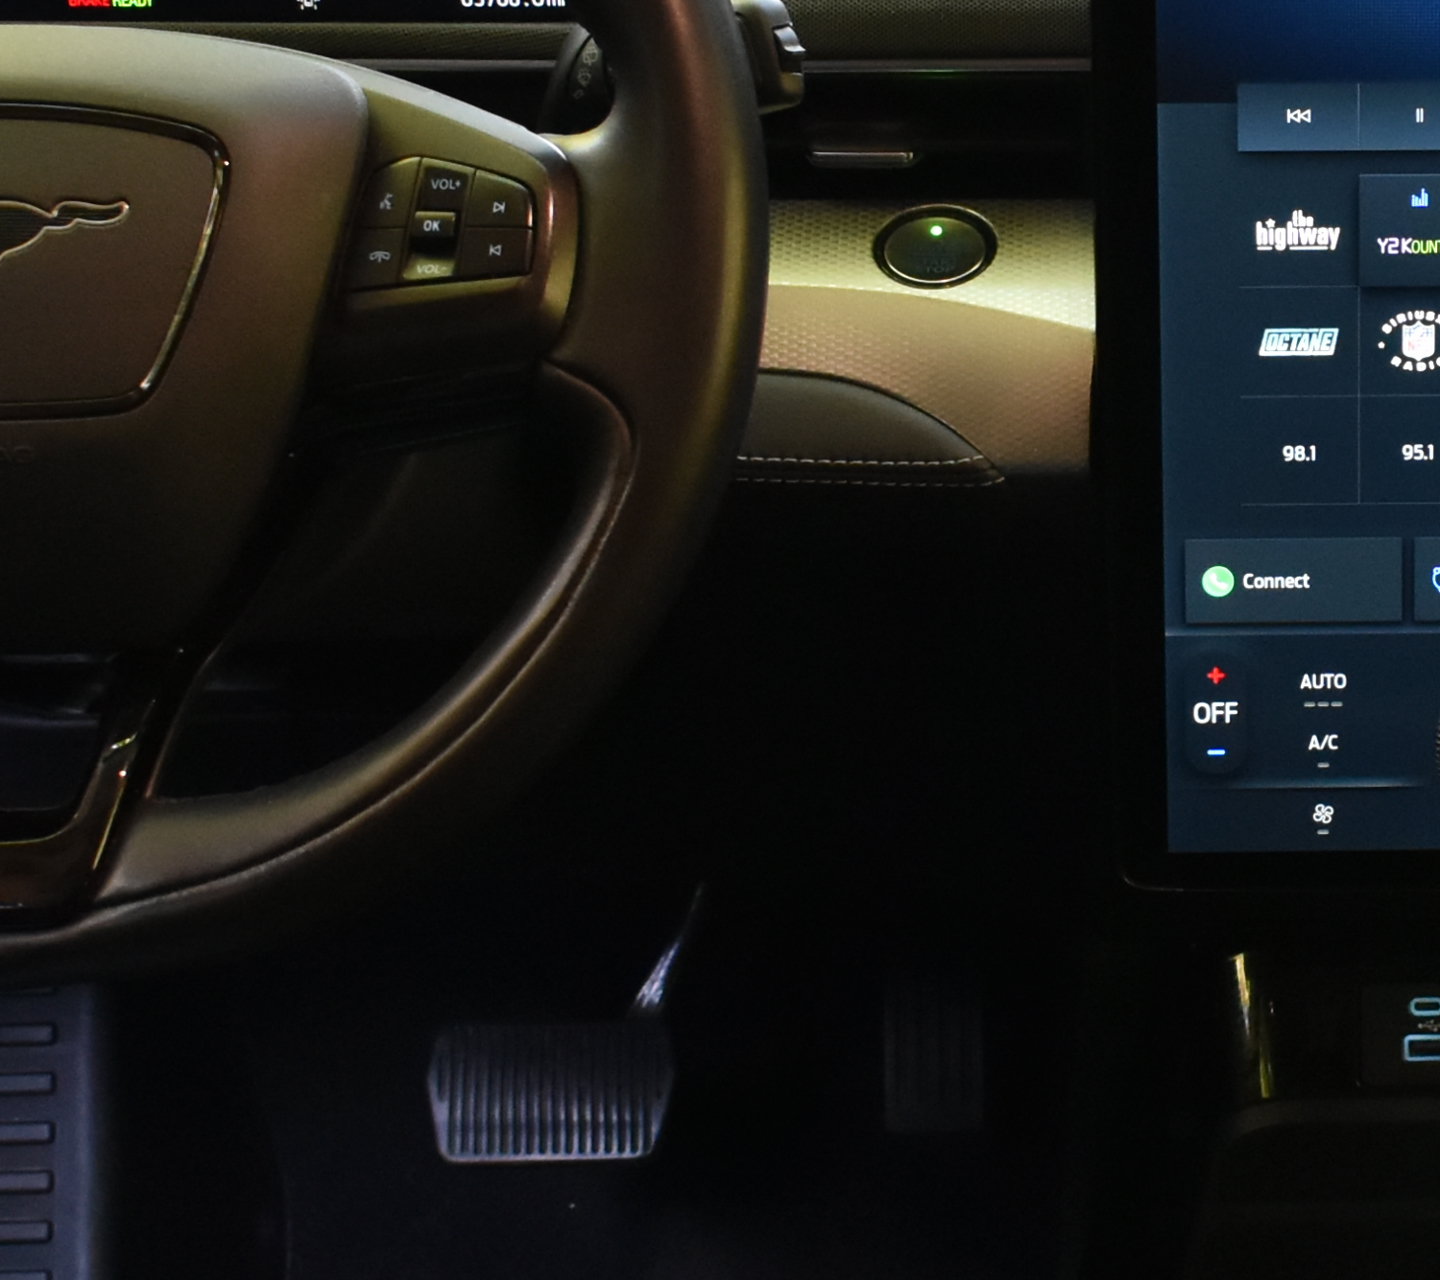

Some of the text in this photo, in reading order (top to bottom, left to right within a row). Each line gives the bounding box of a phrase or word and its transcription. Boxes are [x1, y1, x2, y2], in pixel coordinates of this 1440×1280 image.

[423, 220, 441, 232] OK
[1292, 210, 1314, 227] the
[1256, 220, 1340, 251] highway
[1265, 333, 1333, 352] OCTANE
[1282, 445, 1317, 462] 98.1
[1402, 444, 1435, 461] 95.1
[1243, 572, 1310, 588] Connect
[1300, 673, 1347, 690] AUTO
[1193, 702, 1238, 725] OFF
[1309, 734, 1338, 752] A/C
